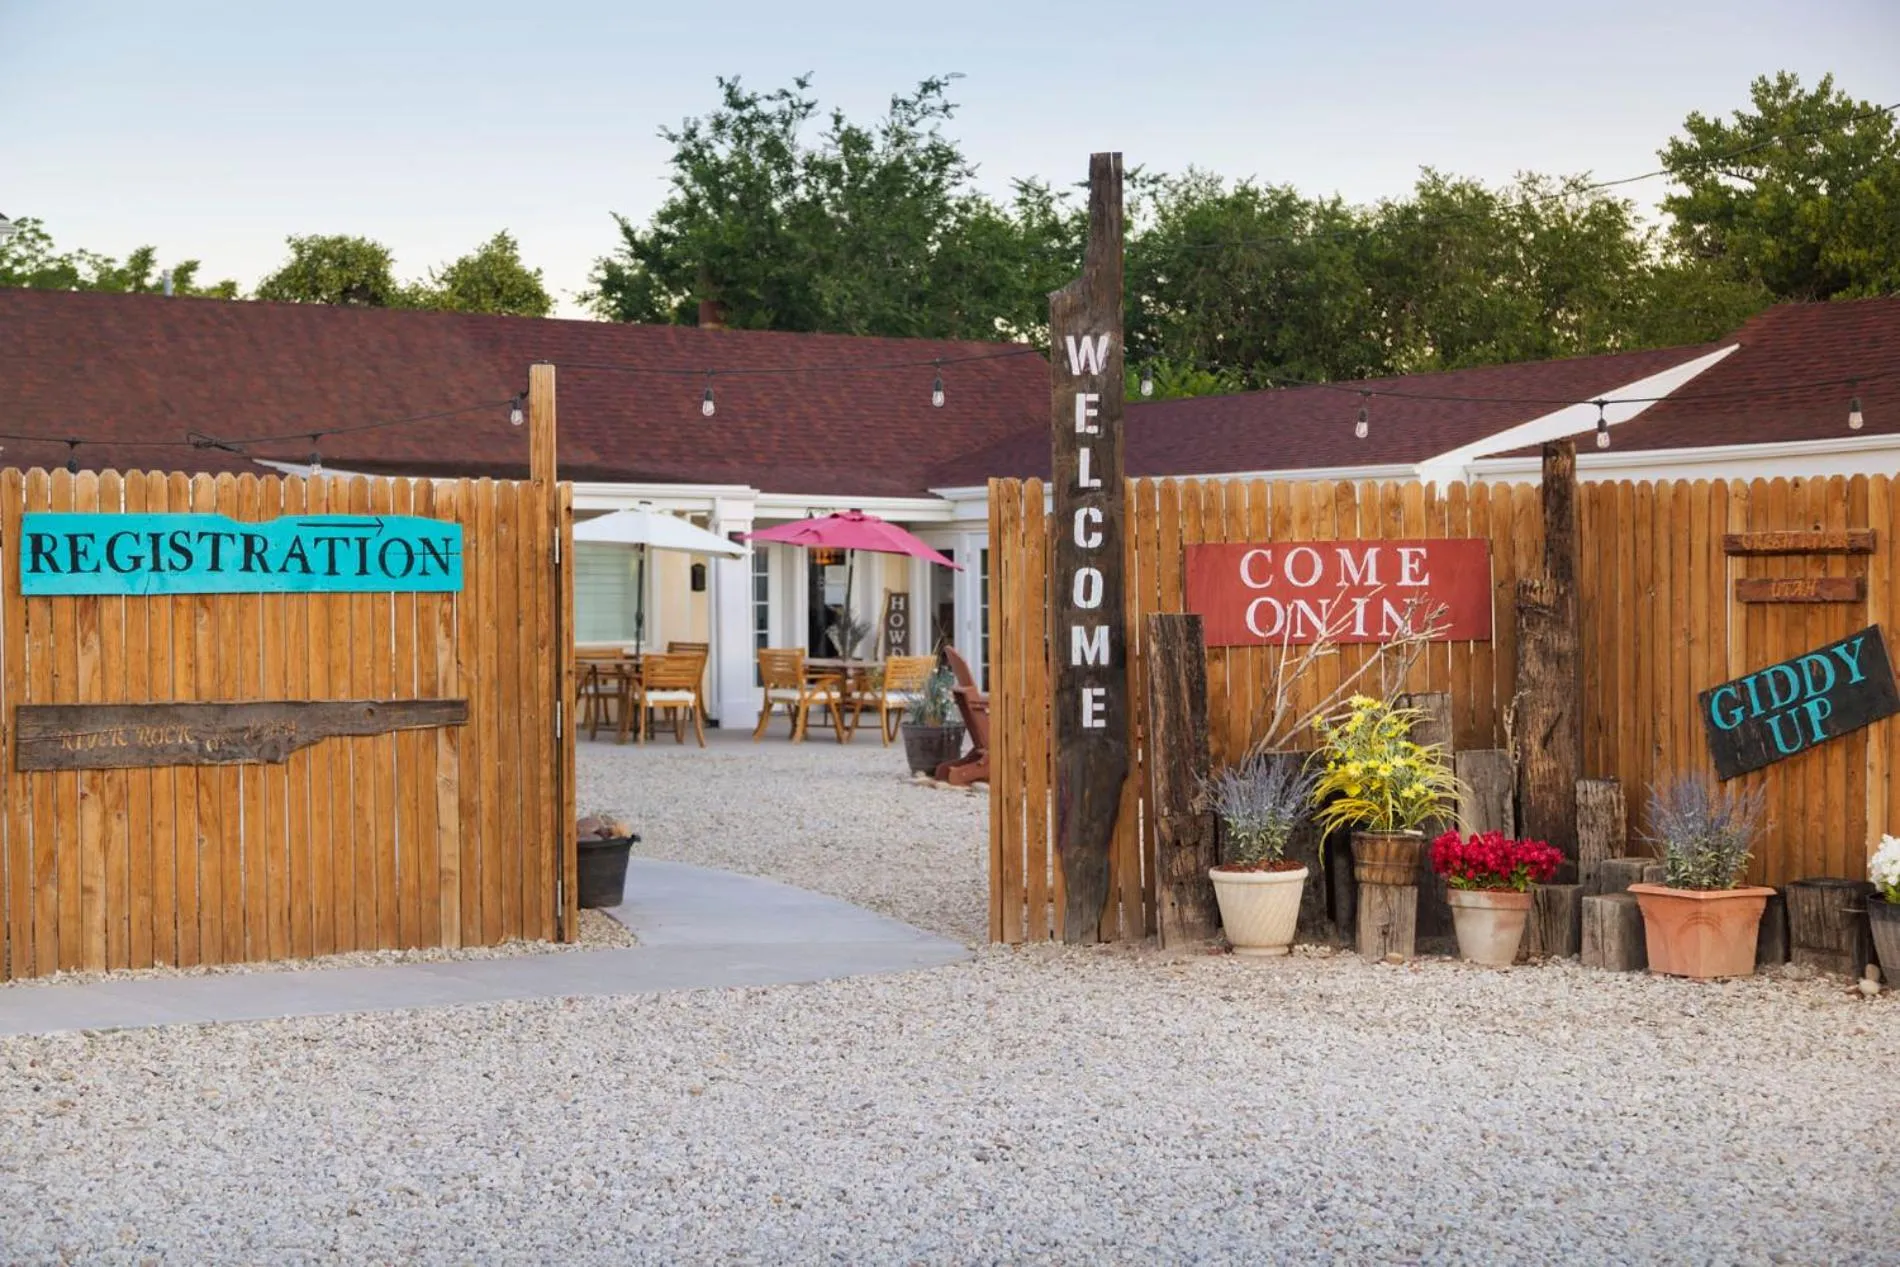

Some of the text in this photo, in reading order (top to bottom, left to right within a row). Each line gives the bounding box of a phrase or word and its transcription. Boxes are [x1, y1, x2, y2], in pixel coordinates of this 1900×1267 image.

[26, 530, 455, 579] REGISTRATION
[1065, 334, 1110, 728] WELCOME
[1239, 546, 1429, 589] COME
[889, 596, 906, 656] HOWD
[1245, 597, 1417, 639] ON IN
[1711, 637, 1866, 730] GIDDY
[136, 723, 197, 748] ROCK
[1766, 697, 1832, 753] UP
